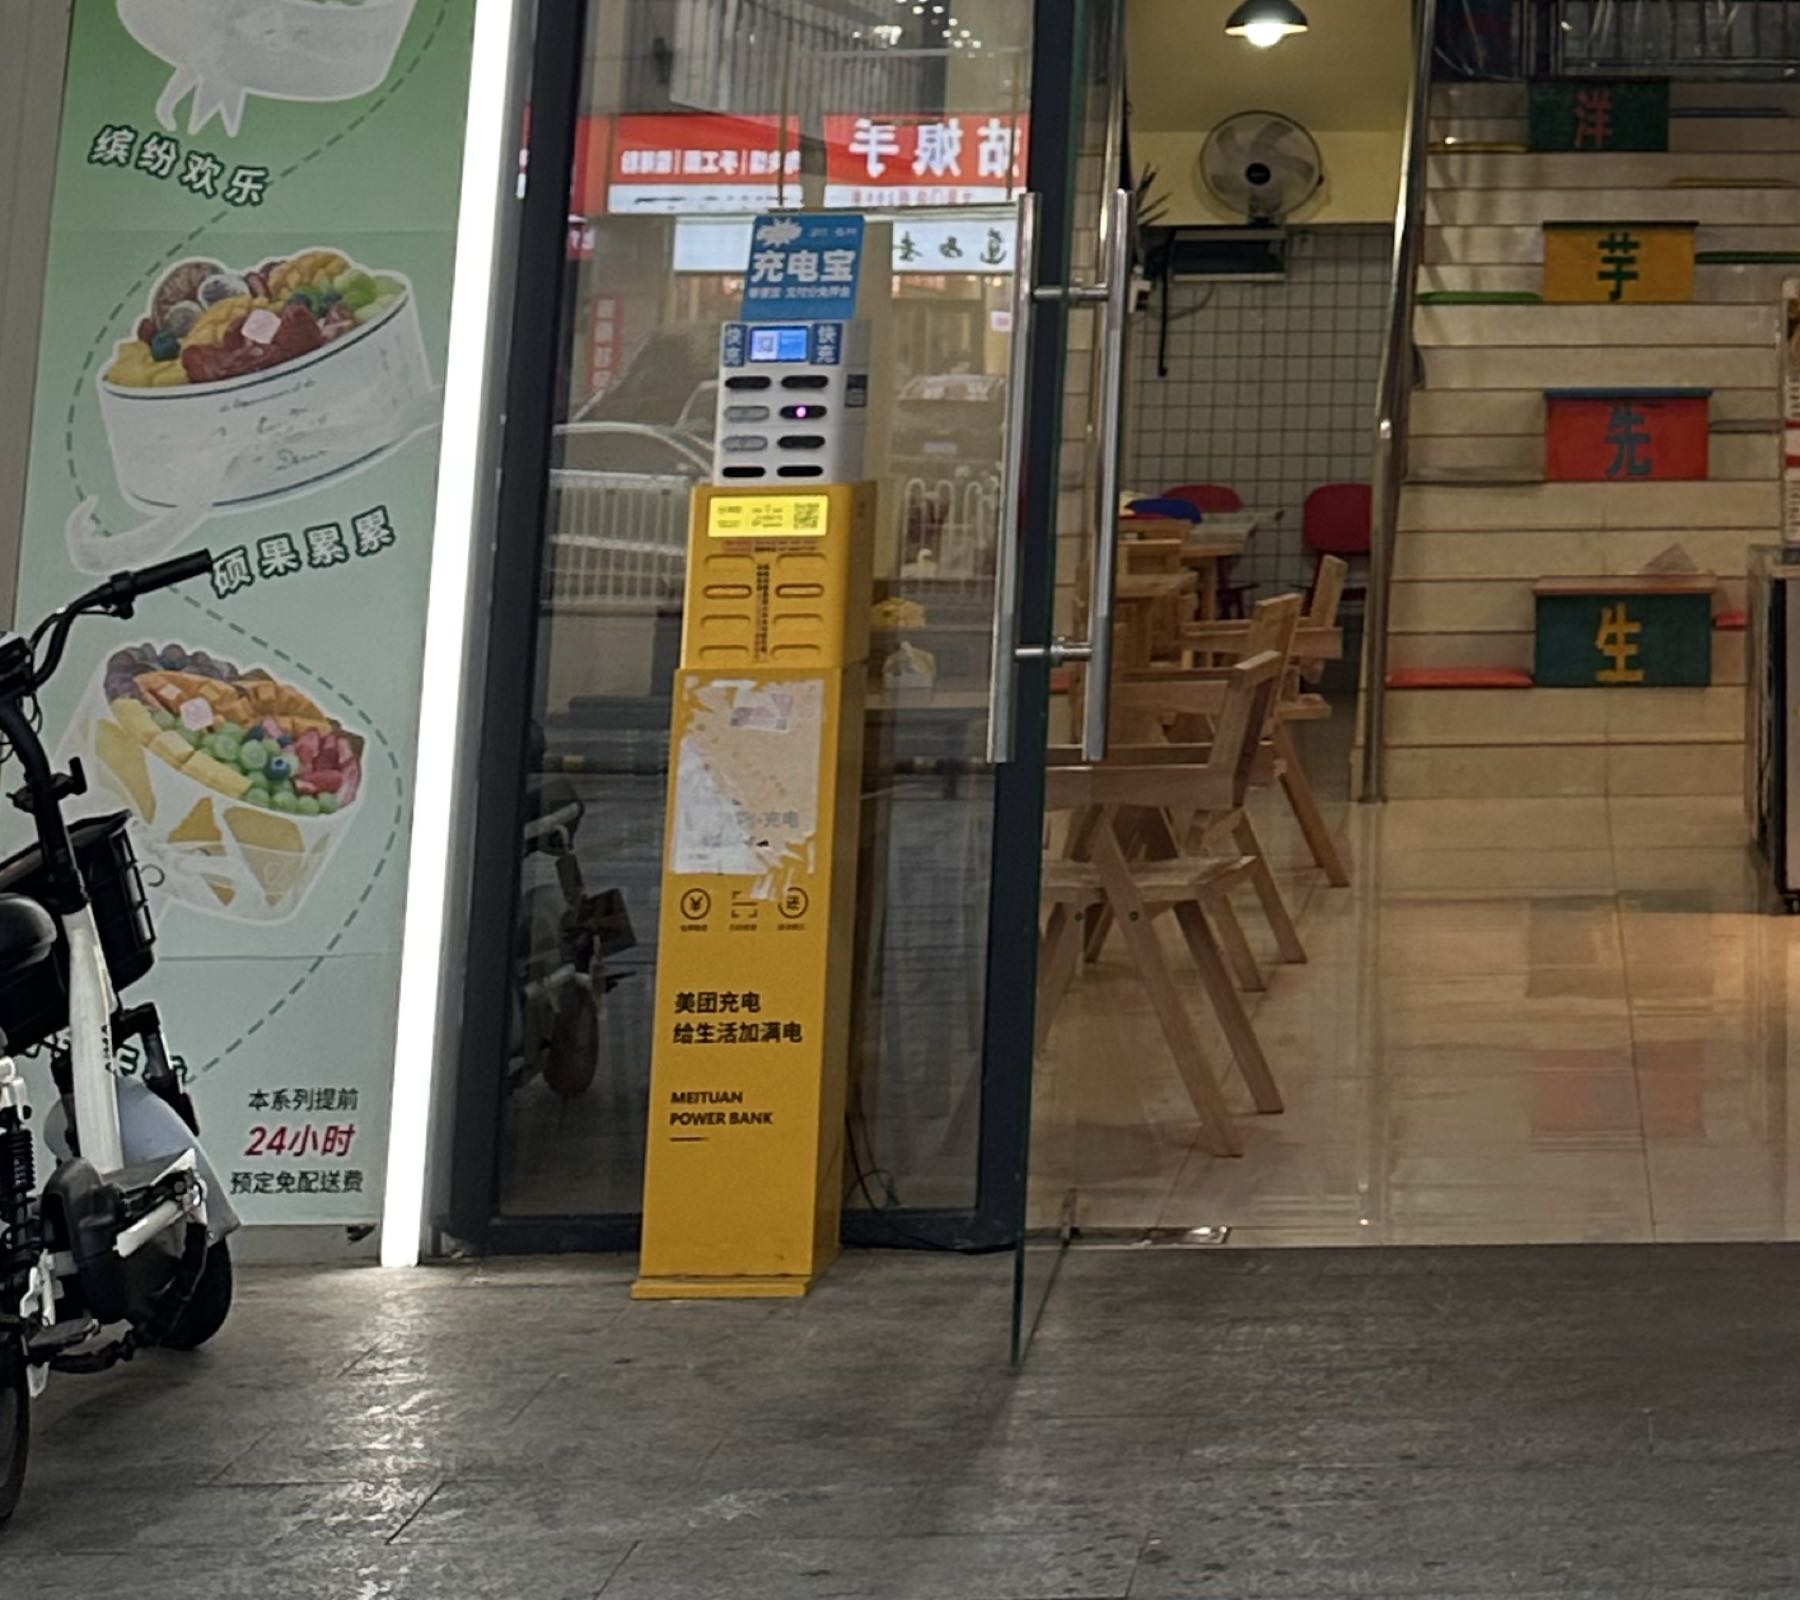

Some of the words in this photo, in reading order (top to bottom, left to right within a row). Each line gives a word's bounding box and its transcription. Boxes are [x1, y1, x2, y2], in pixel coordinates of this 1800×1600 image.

[89, 126, 268, 206] 缤纷欢乐
[750, 249, 857, 283] 充电宝
[1598, 231, 1641, 302] 芋
[1604, 402, 1652, 479] 先
[212, 507, 395, 598] 硕果累累
[1595, 601, 1645, 682] 生
[674, 991, 762, 1015] 美团充电
[672, 1021, 804, 1045] 给生活加满电
[248, 1087, 360, 1112] 本系列提前
[670, 1091, 744, 1105] MEITUAN
[669, 1111, 727, 1127] POWER
[729, 1111, 775, 1126] BANK
[243, 1122, 357, 1158] 24小时
[230, 1168, 364, 1196] 预定免配送费
